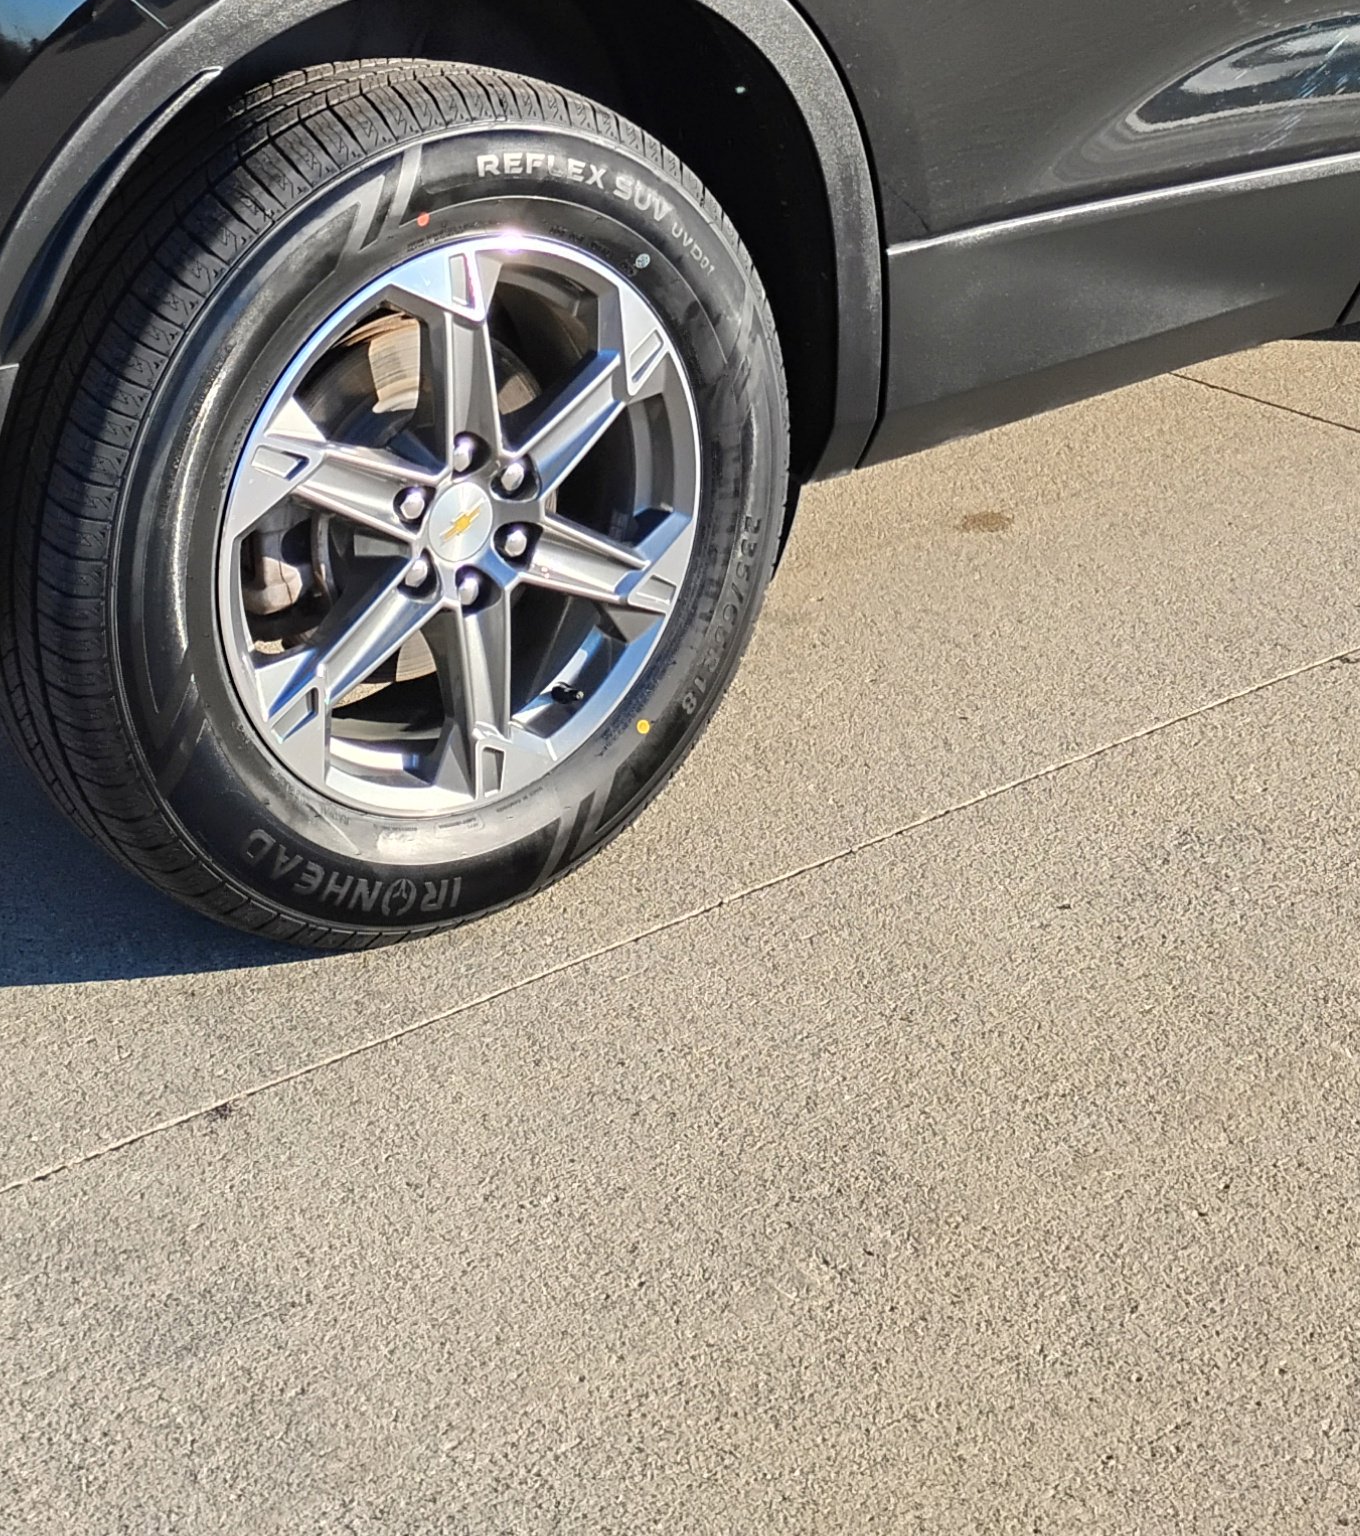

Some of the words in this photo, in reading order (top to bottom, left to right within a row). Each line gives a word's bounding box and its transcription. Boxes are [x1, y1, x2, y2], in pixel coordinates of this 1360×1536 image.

[476, 152, 608, 190] REFLEX
[612, 172, 675, 222] SUV
[245, 828, 462, 916] IRONHEAD
